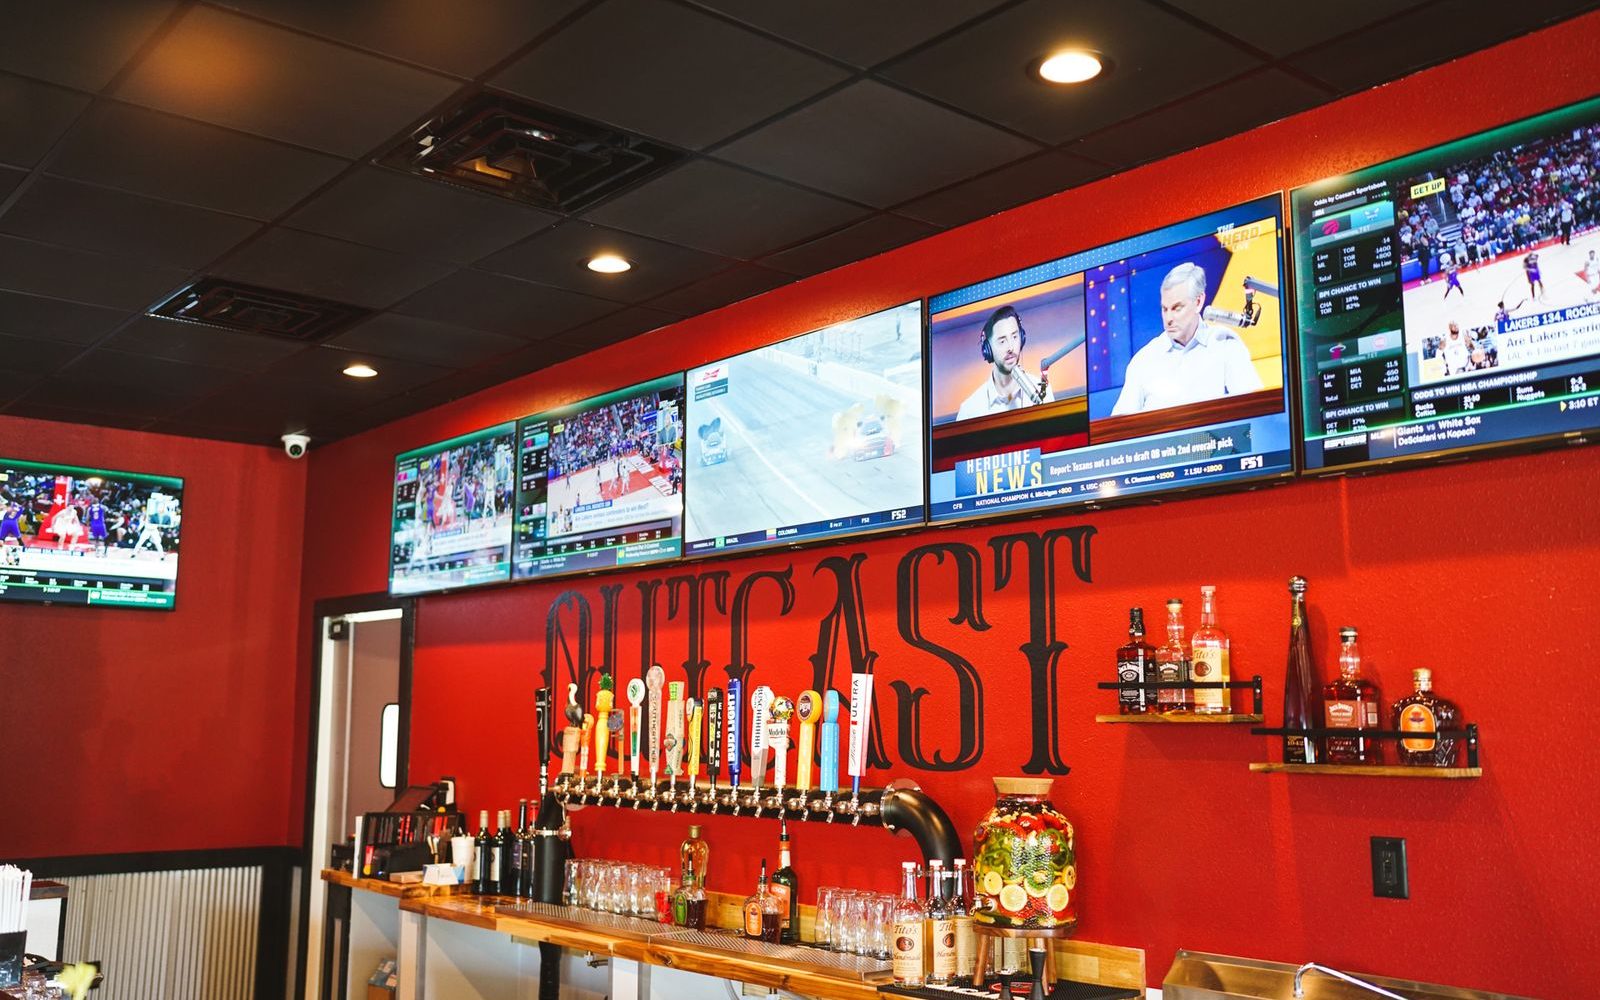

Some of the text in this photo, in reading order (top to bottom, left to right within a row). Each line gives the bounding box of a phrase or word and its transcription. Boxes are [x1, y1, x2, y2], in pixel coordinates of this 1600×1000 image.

[1432, 182, 1442, 191] UP
[1216, 222, 1234, 233] THE
[1344, 254, 1356, 262] TOR
[1330, 282, 1358, 296] CHANCE
[1358, 280, 1367, 288] TO
[1368, 278, 1382, 286] WIN
[1504, 315, 1540, 332] LAKERS
[1566, 304, 1600, 320] ROCKE
[1507, 338, 1525, 348] Are
[1530, 330, 1568, 344] Lakers
[1446, 386, 1460, 394] WIN
[1478, 372, 1538, 388] CHAMPIONSHIP
[1338, 406, 1364, 416] CHANCE
[1375, 402, 1388, 410] WIN
[1587, 398, 1598, 407] ET
[1398, 425, 1424, 436] Giants
[1438, 419, 1463, 430] White
[1465, 416, 1481, 425] Sox
[966, 448, 1030, 474] HERDLINE
[1050, 464, 1072, 476] Report:
[1072, 460, 1093, 471] Texans
[1094, 458, 1105, 468] not
[1111, 454, 1124, 466] lock
[1126, 454, 1132, 463] to
[1134, 451, 1150, 462] draft
[1161, 446, 1177, 458] with
[1178, 444, 1190, 454] 2nd
[1192, 440, 1216, 453] overall
[1217, 437, 1234, 450] pick
[1240, 456, 1264, 470] FS1
[975, 496, 1000, 507] NATIONAL
[1000, 492, 1029, 504] CHAMPION
[1086, 480, 1098, 490] USC
[1189, 466, 1202, 476] LSU
[976, 461, 1042, 495] NEWS
[892, 510, 907, 520] FS2
[541, 526, 1098, 775] OUTCAST
[728, 692, 736, 762] BUD LIGHT
[768, 728, 786, 736] Modelo
[894, 924, 918, 934] Tito's
